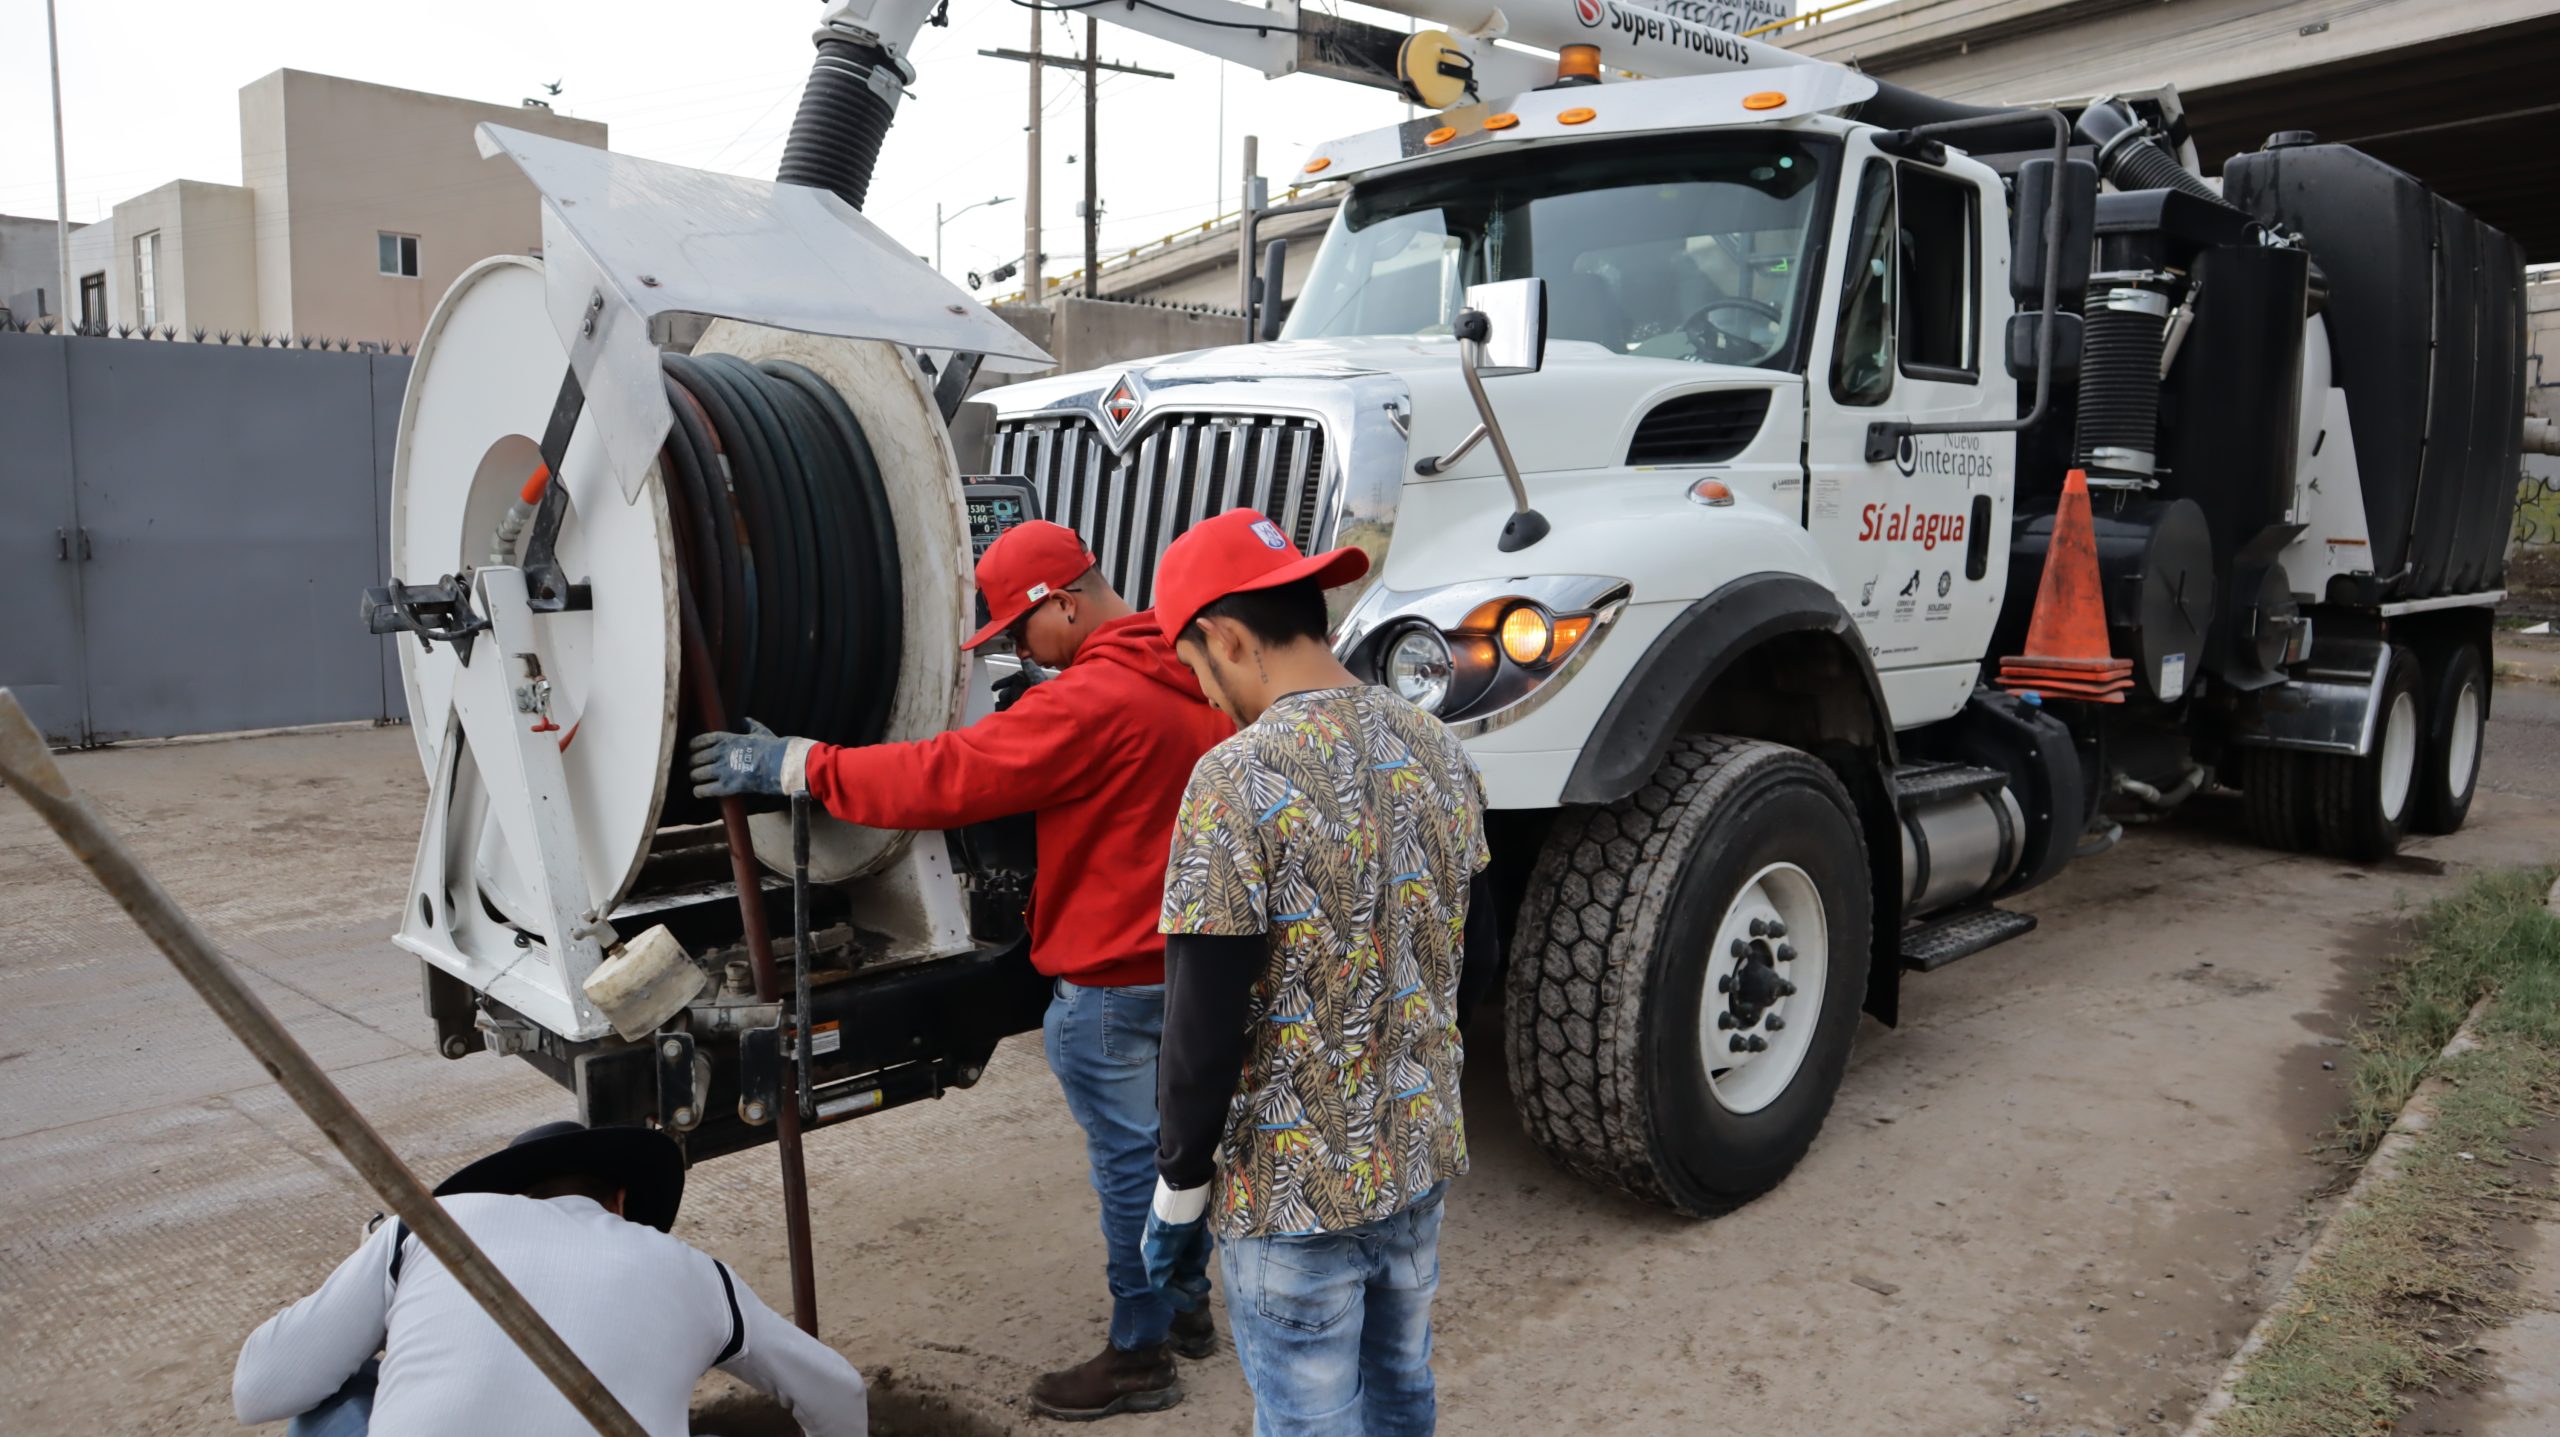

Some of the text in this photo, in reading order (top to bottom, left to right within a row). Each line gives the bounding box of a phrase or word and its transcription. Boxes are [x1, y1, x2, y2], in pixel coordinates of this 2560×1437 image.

[1611, 8, 1750, 65] Super Products
[1919, 440, 1993, 490] interapas
[1944, 432, 1980, 451] Nuevo
[1858, 502, 1965, 551] Sí al agua
